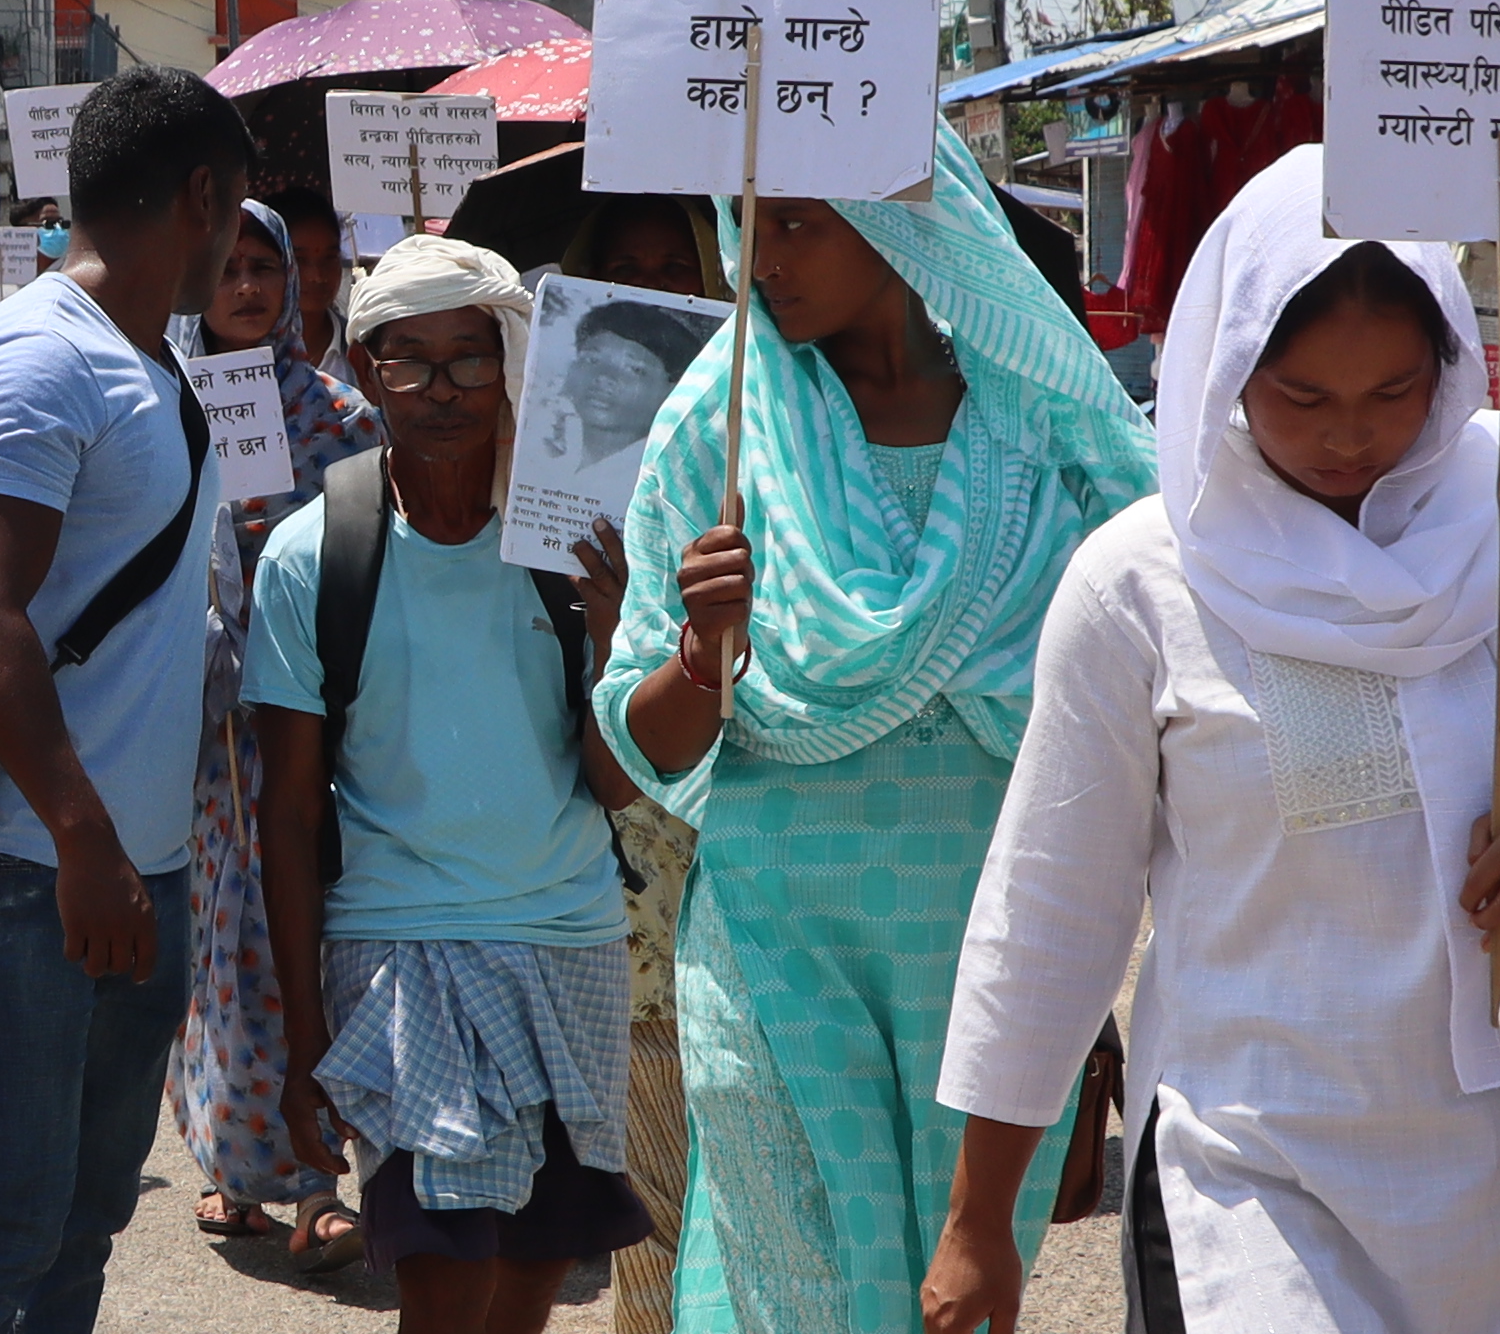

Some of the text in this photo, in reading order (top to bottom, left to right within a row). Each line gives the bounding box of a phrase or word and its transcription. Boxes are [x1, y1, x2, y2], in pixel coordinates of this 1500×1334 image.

[785, 7, 870, 53] मान्छे
[28, 105, 60, 121] पीडित
[350, 99, 385, 117] विगत
[392, 104, 411, 120] १०
[777, 80, 835, 127] छन्
[860, 80, 877, 117] ?
[1378, 105, 1474, 146] ग्यारेन्टी
[435, 182, 454, 196] गर
[204, 401, 257, 426] रिएका
[543, 534, 561, 551] मेरो
